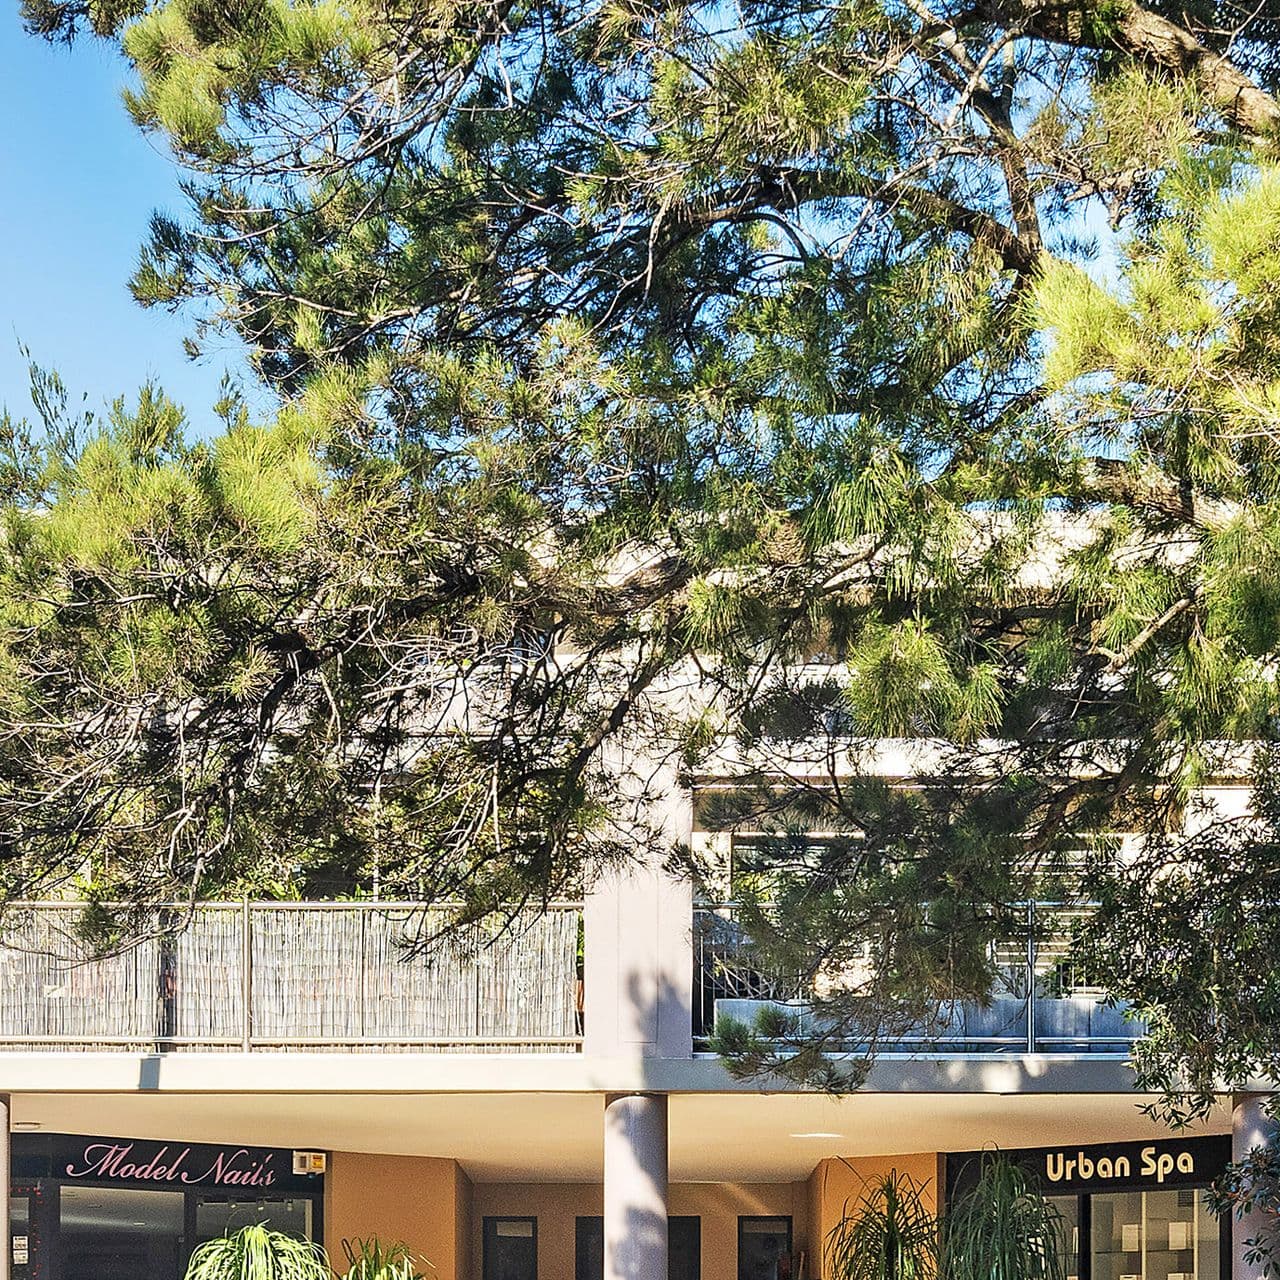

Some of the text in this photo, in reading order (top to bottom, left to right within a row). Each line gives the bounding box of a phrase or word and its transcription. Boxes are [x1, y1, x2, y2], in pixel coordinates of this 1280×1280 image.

[66, 1143, 190, 1180] Model
[1046, 1146, 1194, 1183] Urban Spa
